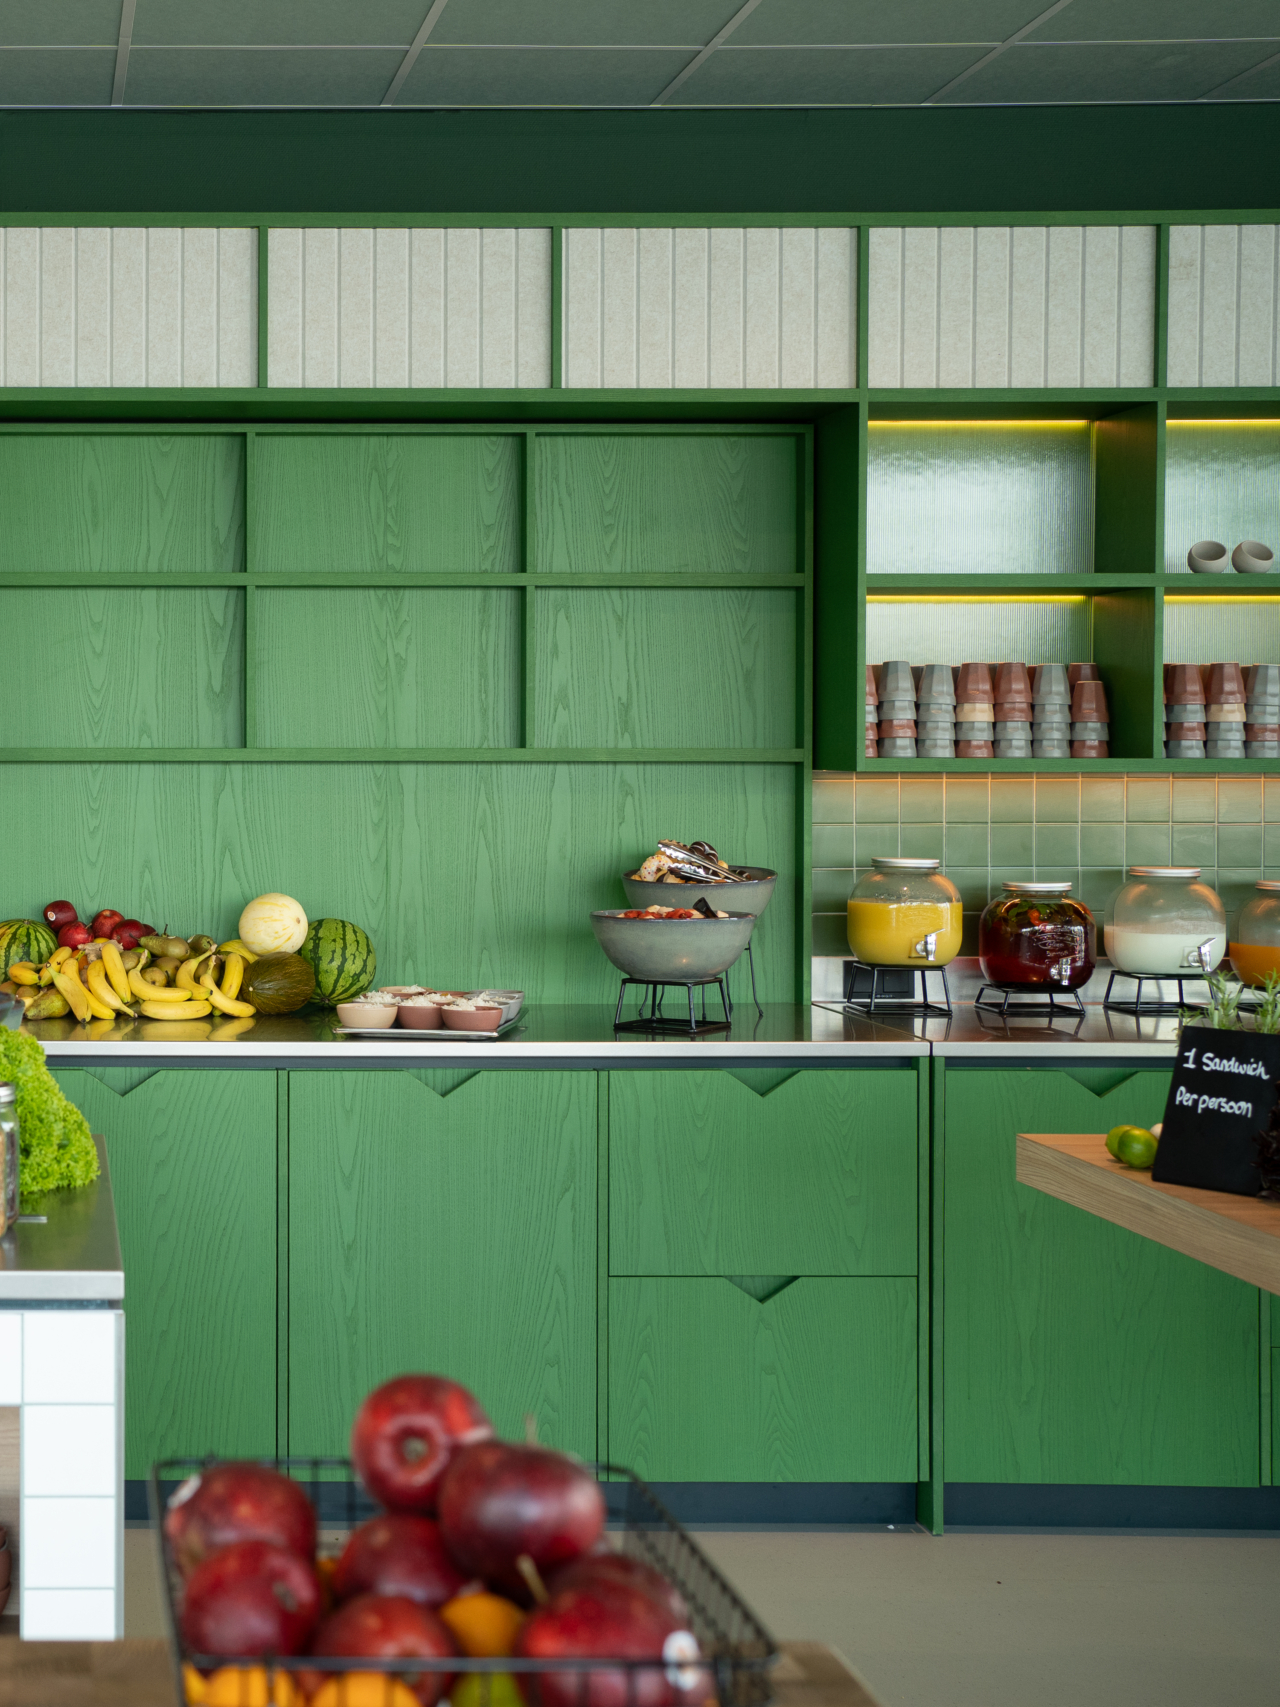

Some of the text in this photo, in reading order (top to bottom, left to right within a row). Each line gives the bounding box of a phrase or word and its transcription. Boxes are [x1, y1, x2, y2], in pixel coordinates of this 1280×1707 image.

[1183, 1048, 1270, 1080] 1 Sandwich
[1197, 1094, 1253, 1118] persoon
